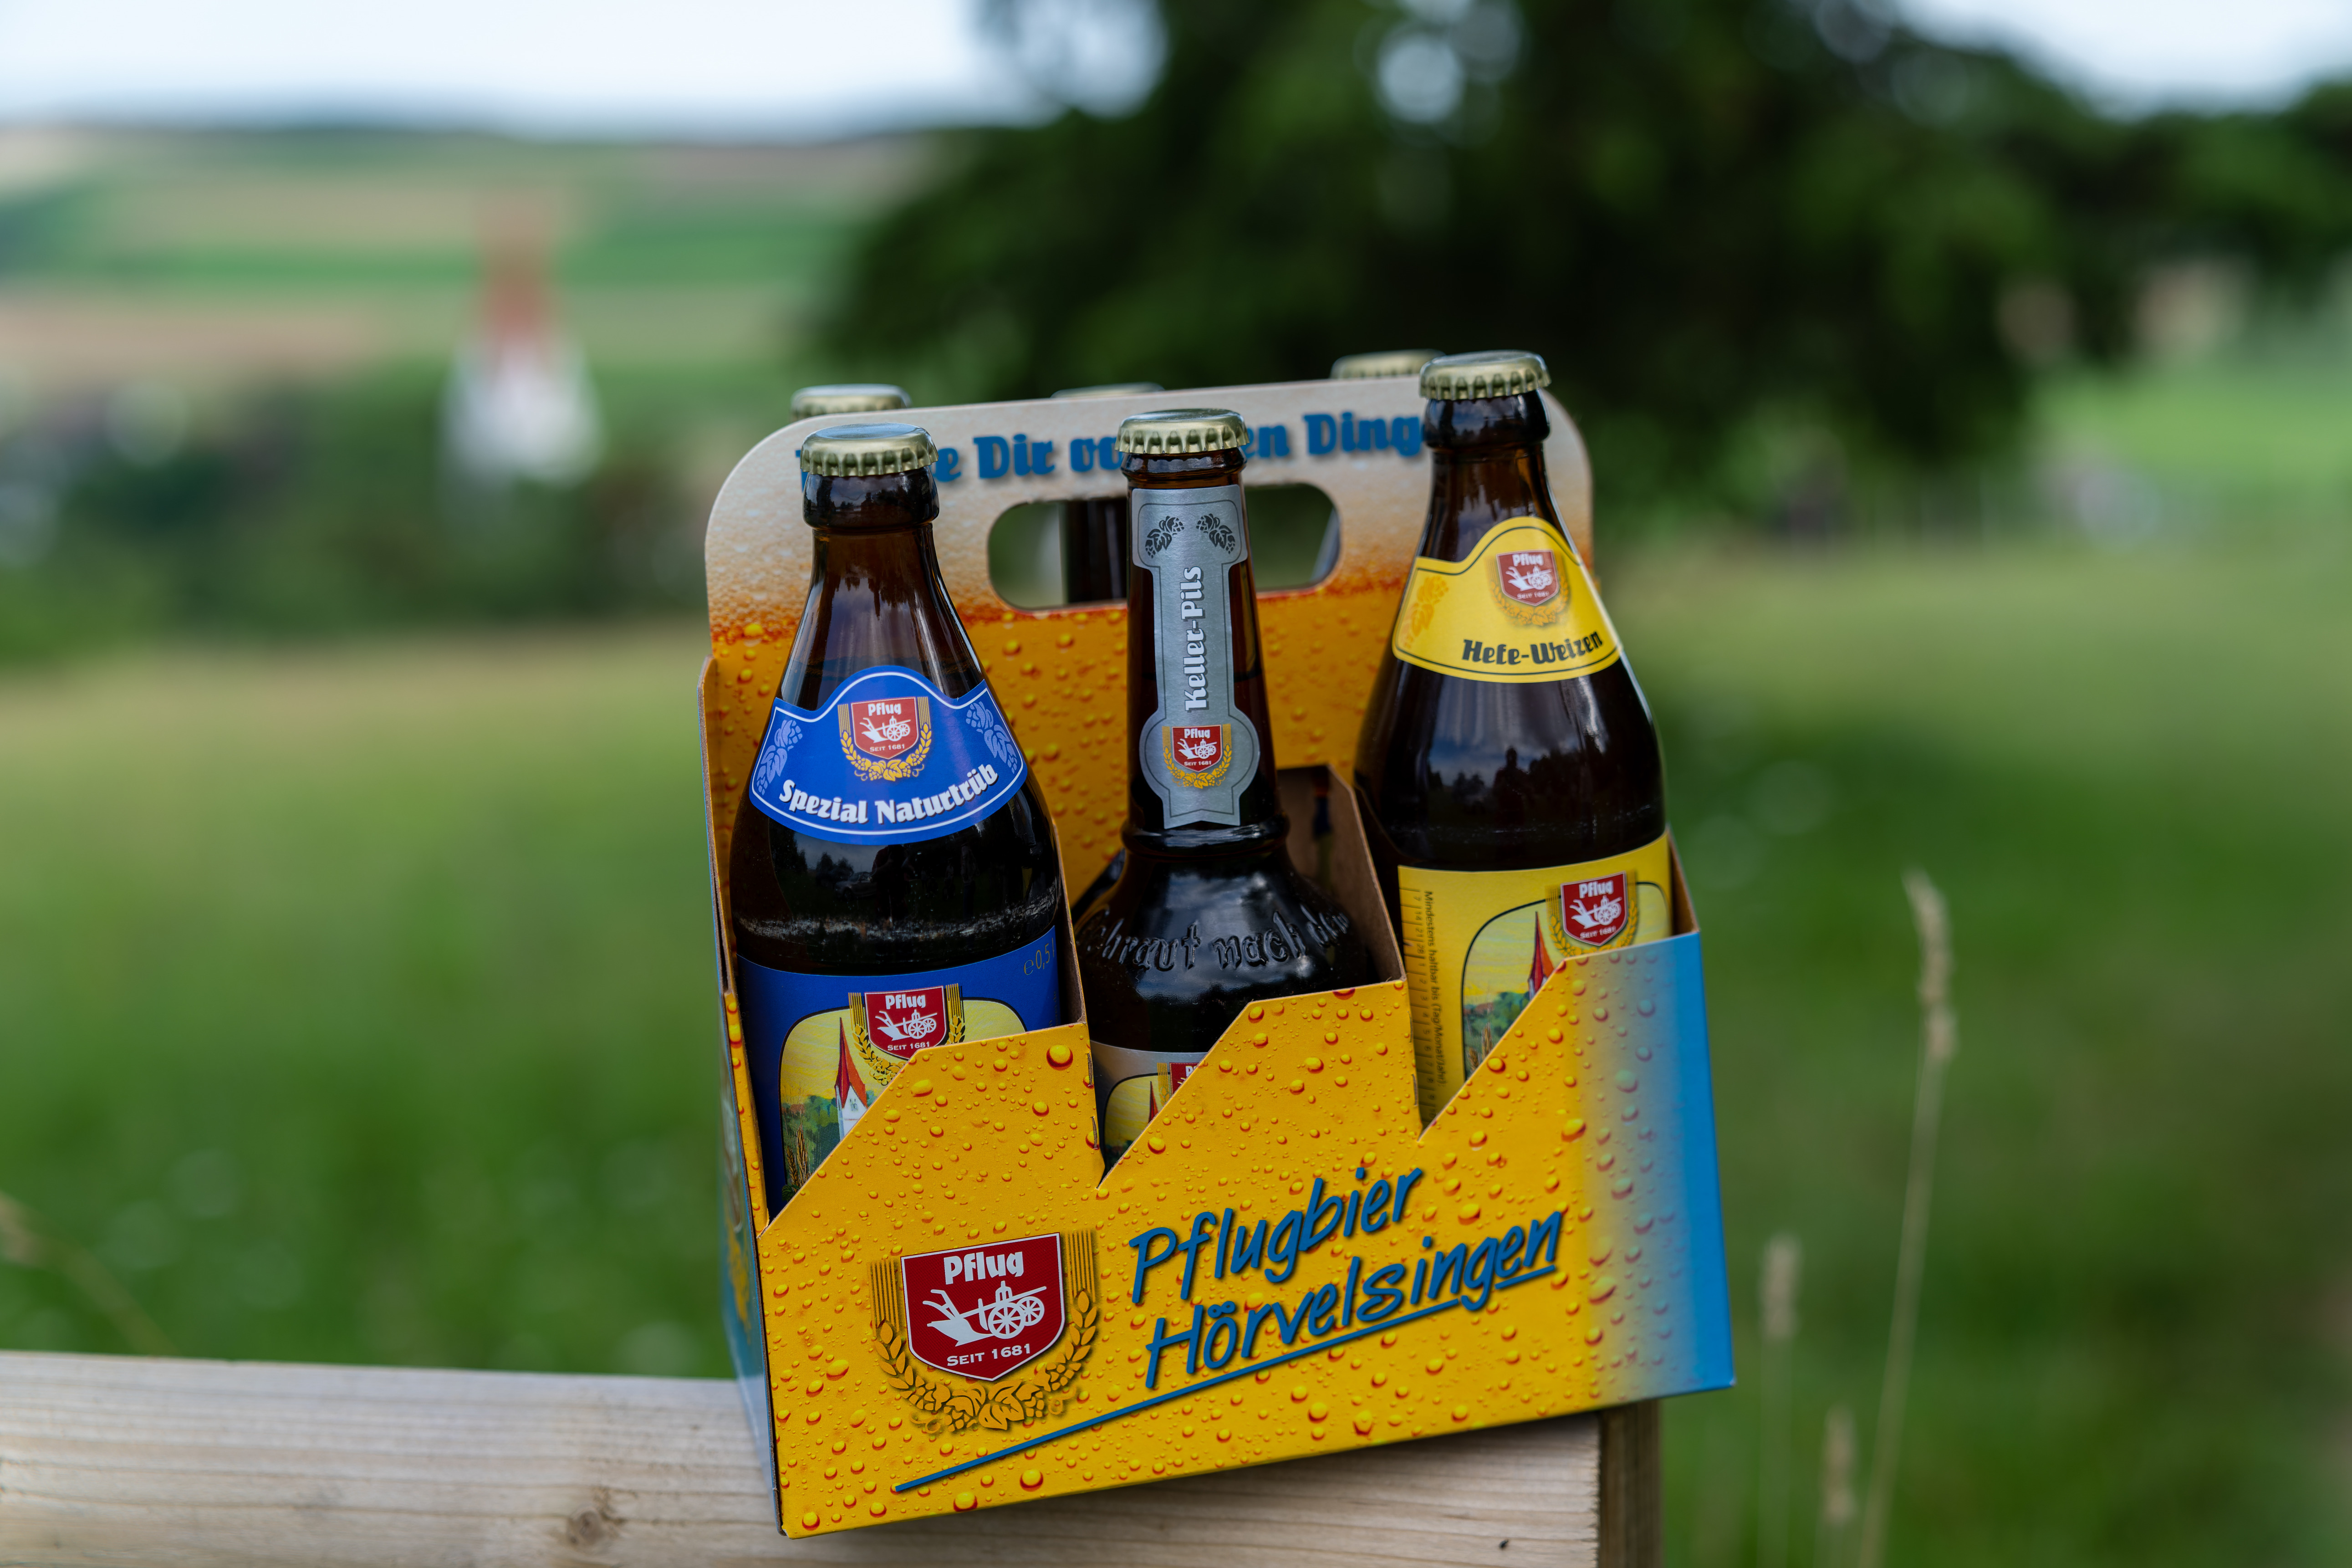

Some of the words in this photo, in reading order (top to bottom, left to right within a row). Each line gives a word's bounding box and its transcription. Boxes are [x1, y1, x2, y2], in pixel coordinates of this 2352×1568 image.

[973, 434, 1055, 480] Dir
[1070, 436, 1123, 472] vo
[1303, 412, 1424, 457] Ding
[1512, 553, 1544, 566] Pflug
[1180, 566, 1209, 711] Keller-Pils
[1462, 630, 1603, 665] Hefe-Weizen
[868, 702, 902, 717] Pflug
[1184, 728, 1210, 739] Pflug
[779, 779, 868, 824] Spezial
[876, 764, 998, 825] Naturtrüb
[1579, 880, 1614, 899] Pflug
[1424, 890, 1435, 946] Mindestens
[1211, 911, 1309, 970] nach
[1429, 950, 1439, 984] haltbar
[885, 994, 926, 1010] Pflug
[1431, 986, 1440, 1001] bis
[909, 1041, 930, 1049] 1681
[1129, 1167, 1423, 1303] Pflugbier
[944, 1251, 1024, 1284] Pflug
[1145, 1211, 1561, 1388] Hörvelsingen
[947, 1352, 985, 1366] SEIT
[992, 1343, 1031, 1359] 1681
